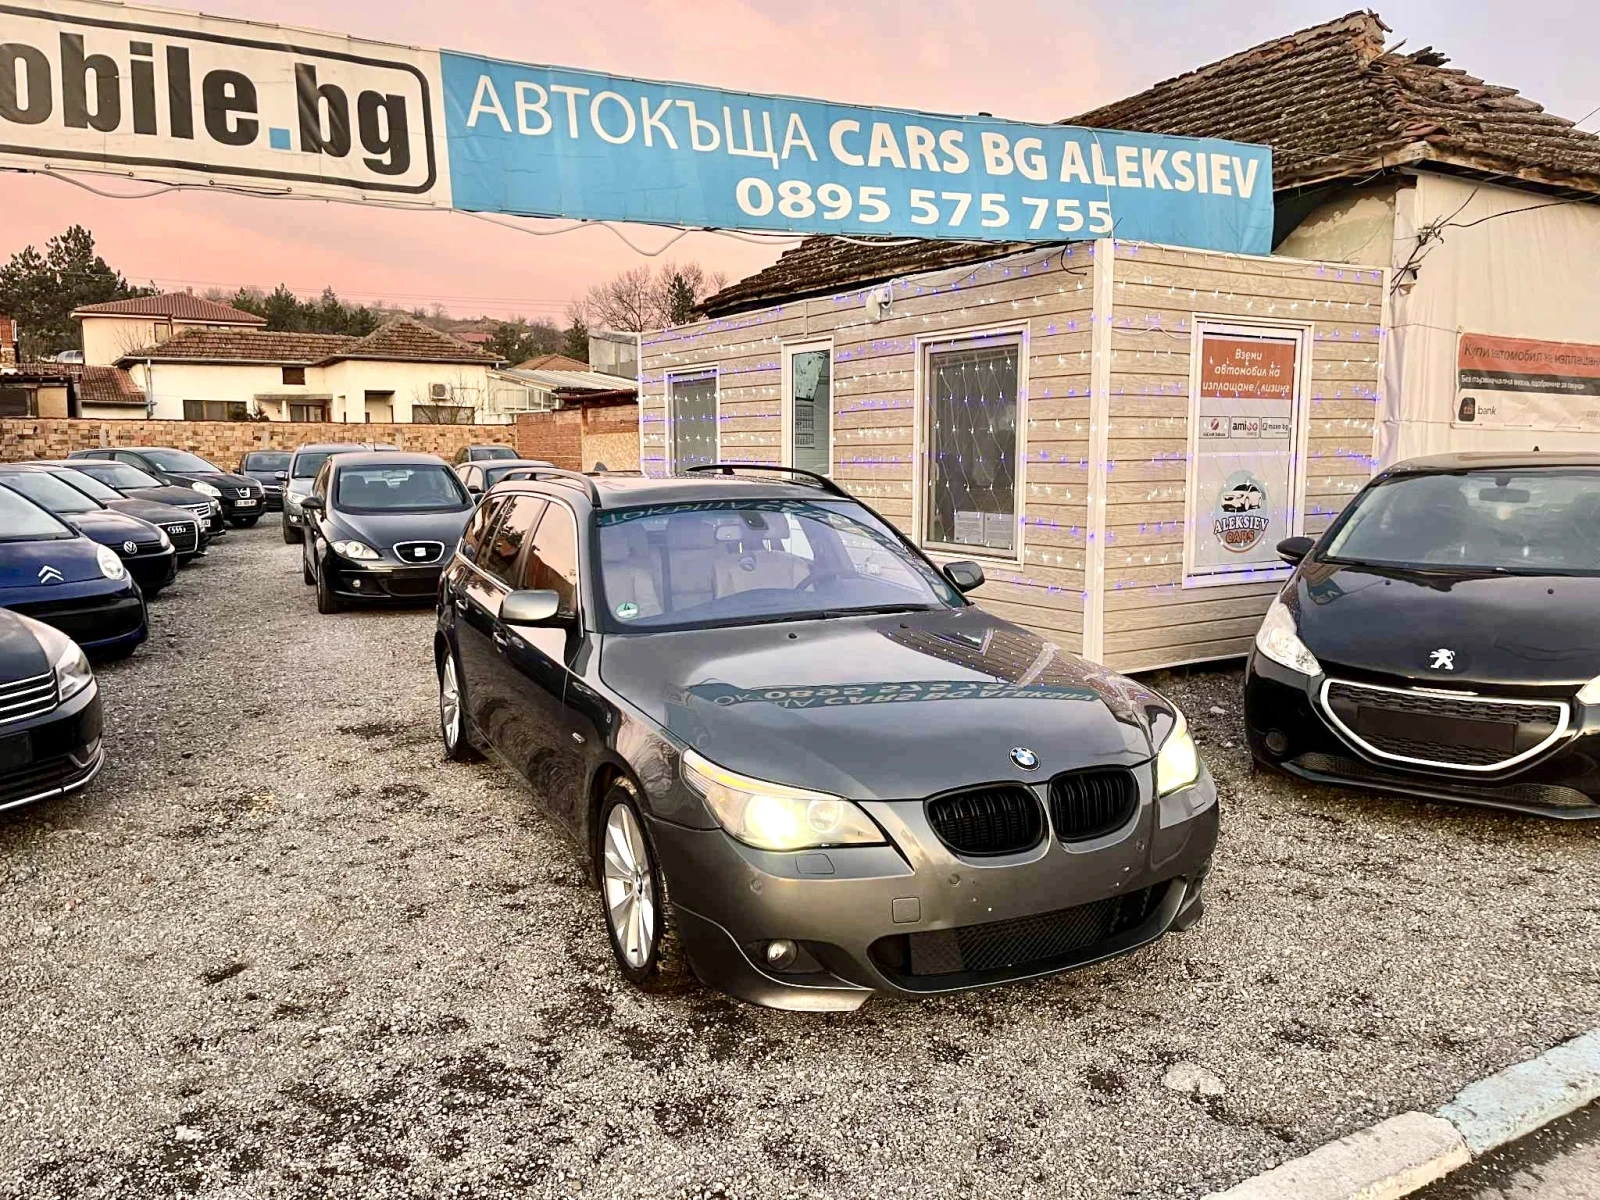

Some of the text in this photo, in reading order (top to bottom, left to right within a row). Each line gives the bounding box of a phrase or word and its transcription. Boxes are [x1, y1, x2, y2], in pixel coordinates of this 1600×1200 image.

[466, 74, 1259, 199] АВТОКЪЩА CARS BG ALEKSIEV
[735, 177, 1114, 234] 0895 575 755
[1234, 348, 1263, 361] Вземи
[1214, 363, 1281, 377] автомобил на
[1214, 515, 1269, 535] ALEKSIEV
[1225, 530, 1255, 544] CARS
